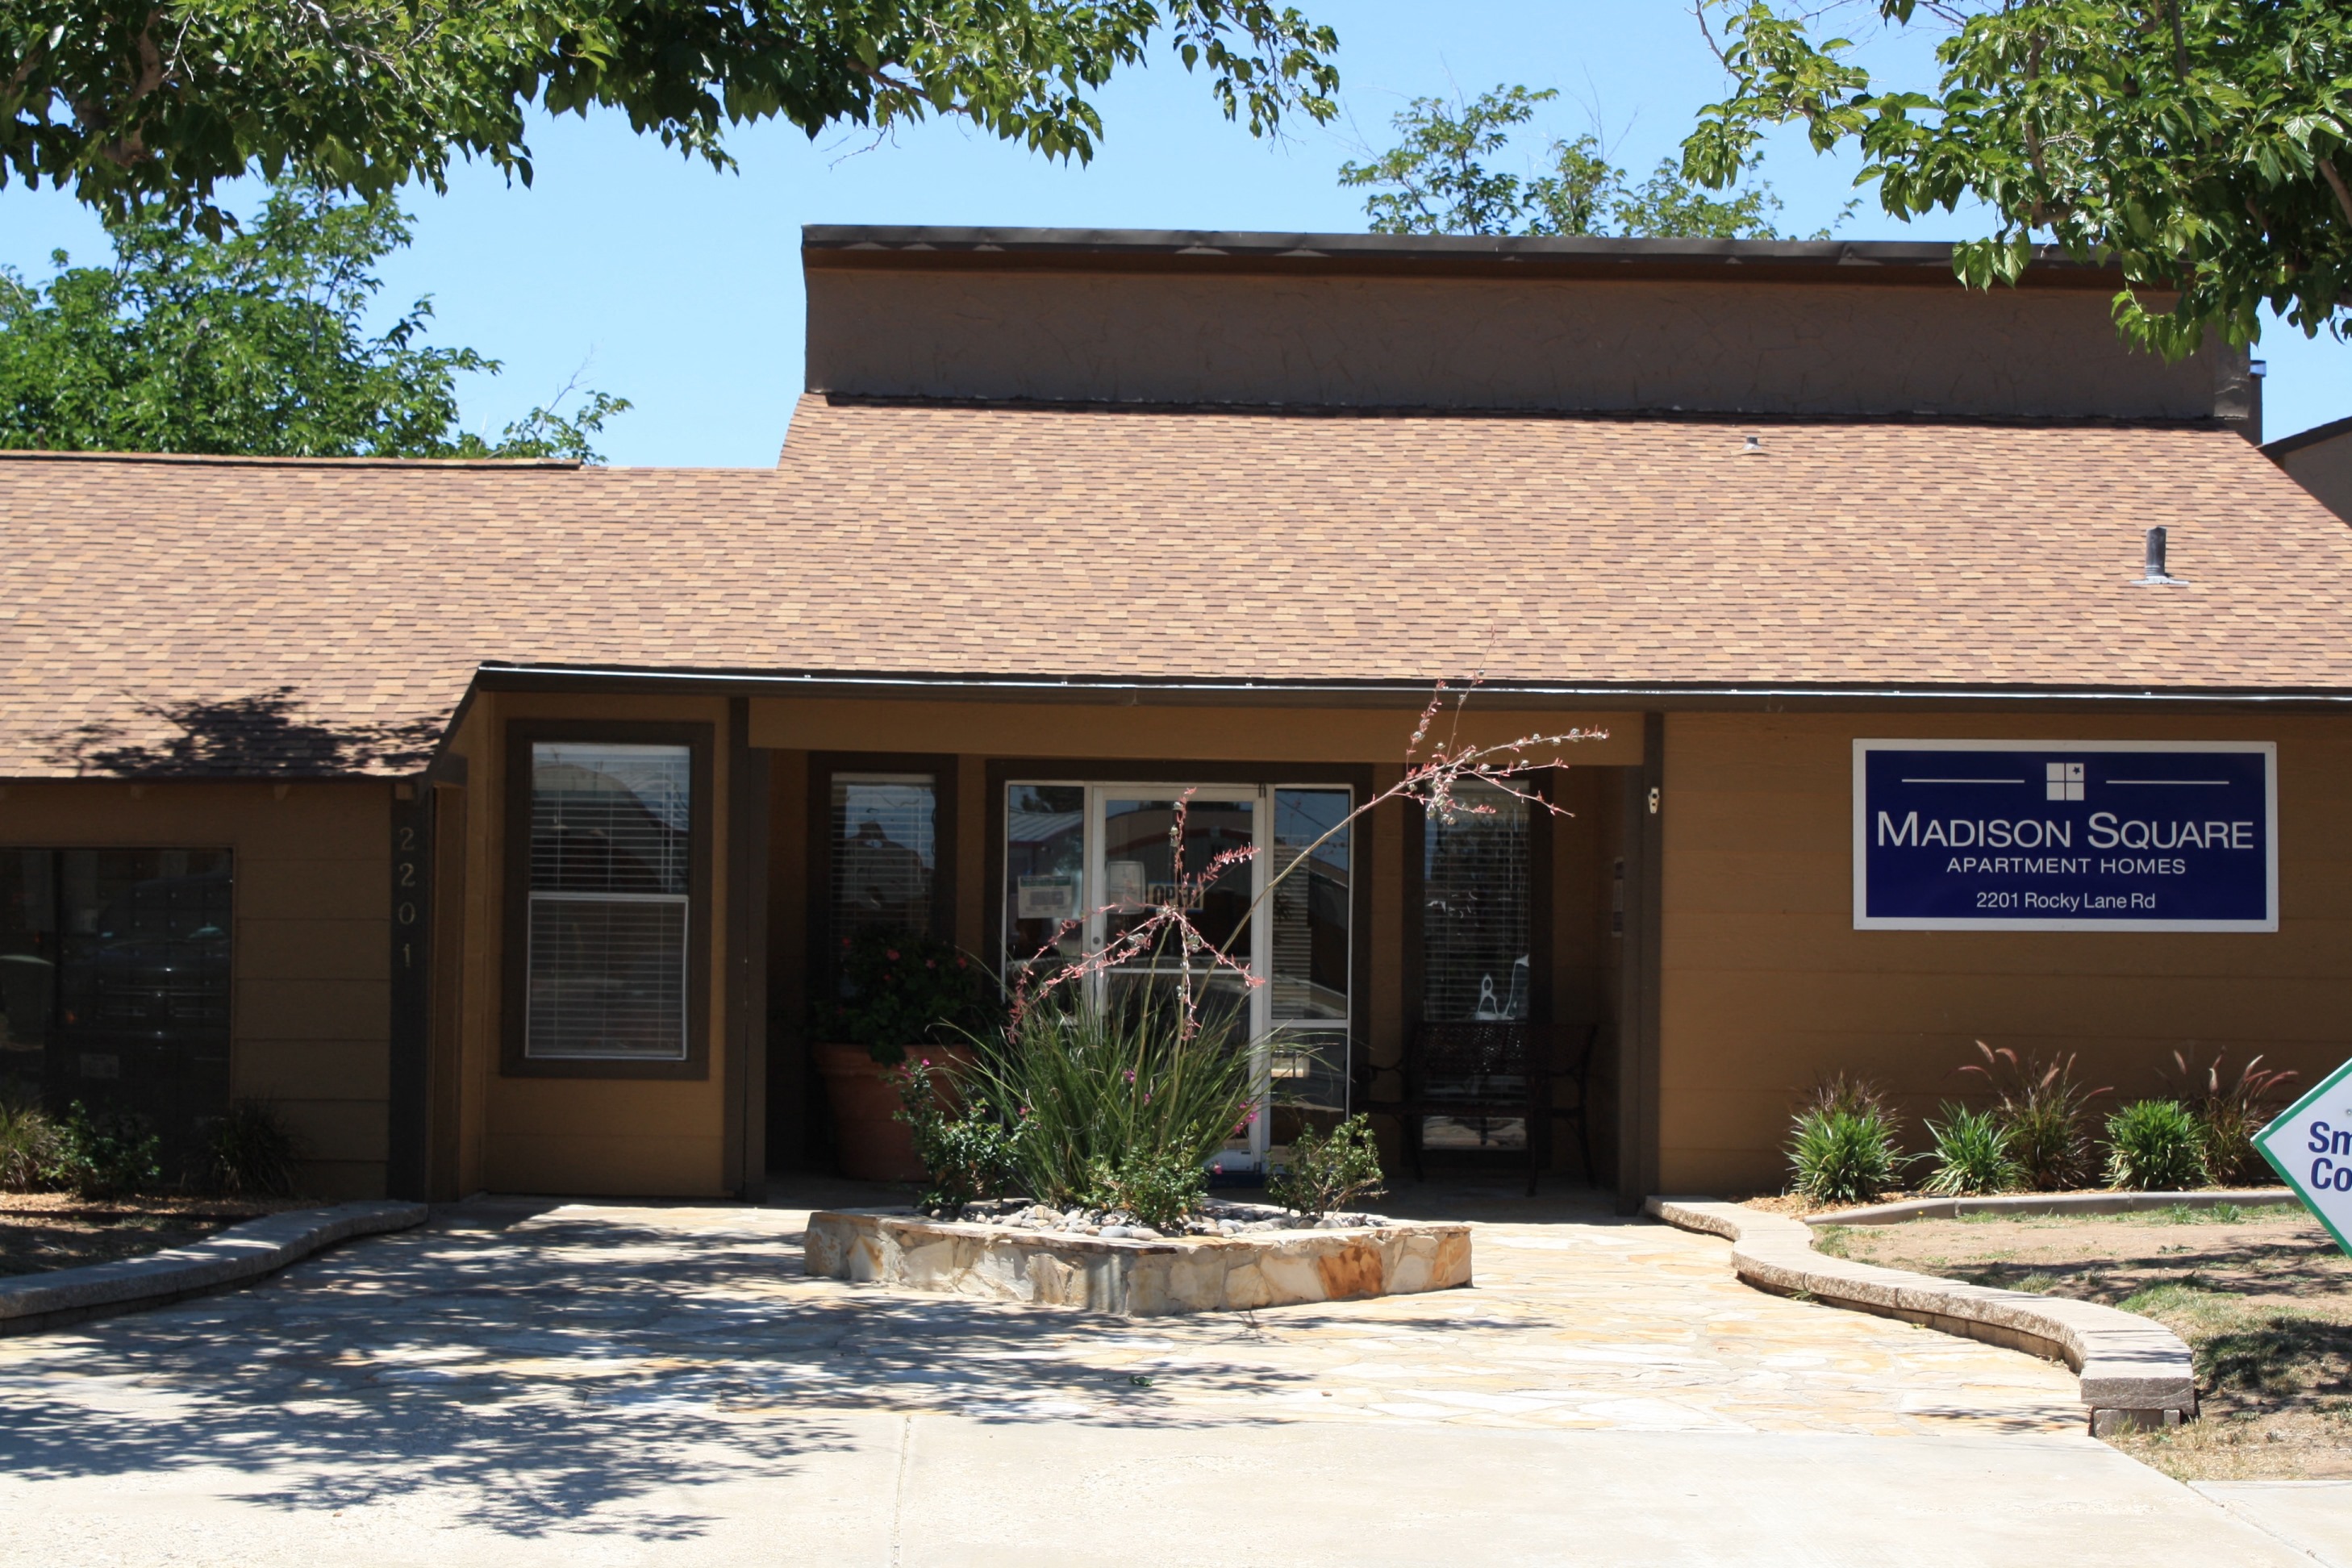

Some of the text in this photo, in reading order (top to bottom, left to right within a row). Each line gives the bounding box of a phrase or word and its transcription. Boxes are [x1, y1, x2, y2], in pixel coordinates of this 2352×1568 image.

[1946, 857, 2186, 874] APARTMENT HOMES
[398, 827, 416, 968] 2201
[1976, 891, 2156, 912] 2201 Rocky Lane Rd
[2310, 1157, 2352, 1192] Co
